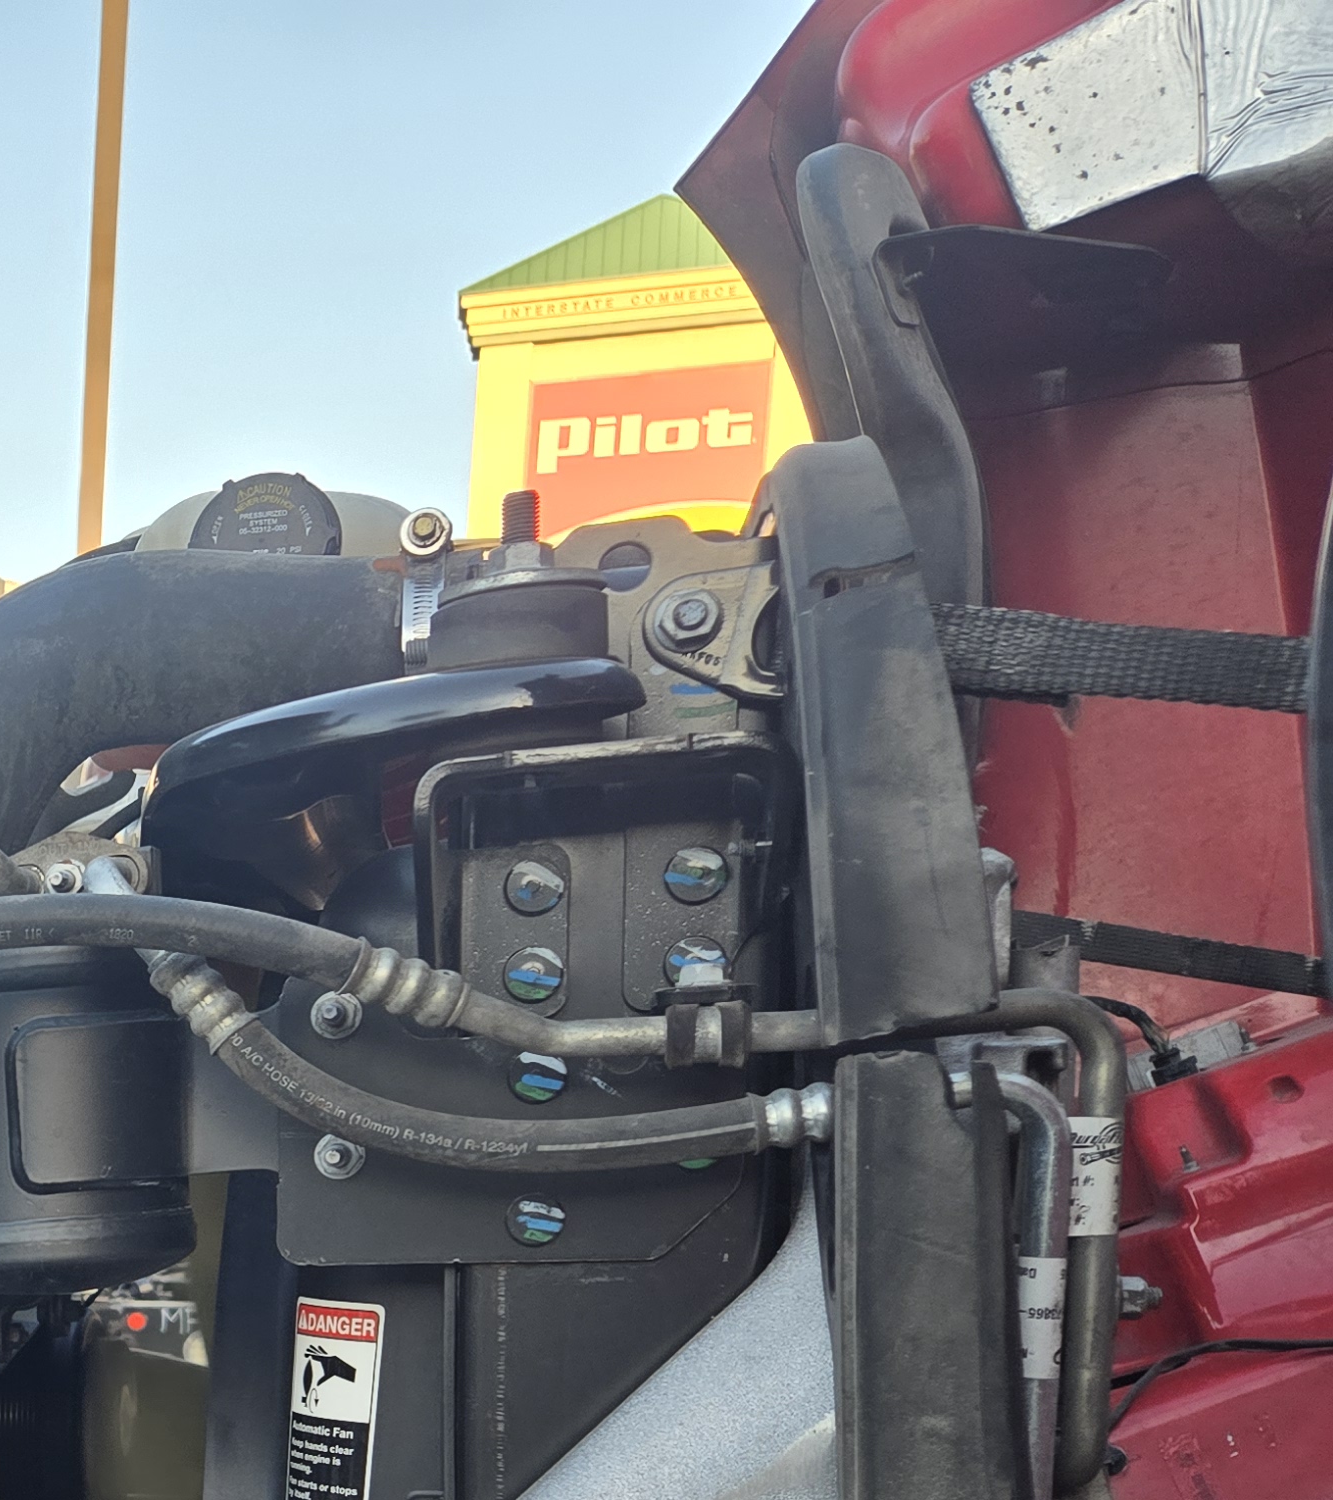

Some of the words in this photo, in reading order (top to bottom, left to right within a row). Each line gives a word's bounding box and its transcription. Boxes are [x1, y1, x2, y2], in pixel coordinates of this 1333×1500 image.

[502, 297, 615, 319] INTERSTATE
[631, 284, 738, 306] COMMERCE
[536, 408, 754, 475] Pilot
[246, 483, 293, 497] CAUTION
[239, 509, 288, 521] PRESSURIZED
[249, 518, 278, 527] SYSTEM
[241, 1045, 263, 1067] A/C
[263, 1064, 299, 1093] HOSE
[333, 1106, 347, 1120] in
[349, 1111, 400, 1140] (10mm)
[307, 1313, 376, 1338] DANGER
[292, 1419, 331, 1438] Automatic
[332, 1426, 354, 1440] Fan
[304, 1439, 328, 1453] hands
[329, 1443, 355, 1456] clear
[304, 1451, 331, 1466] engine
[331, 1456, 342, 1467] is
[297, 1477, 318, 1492] starts
[318, 1482, 330, 1493] or
[330, 1483, 358, 1498] stops
